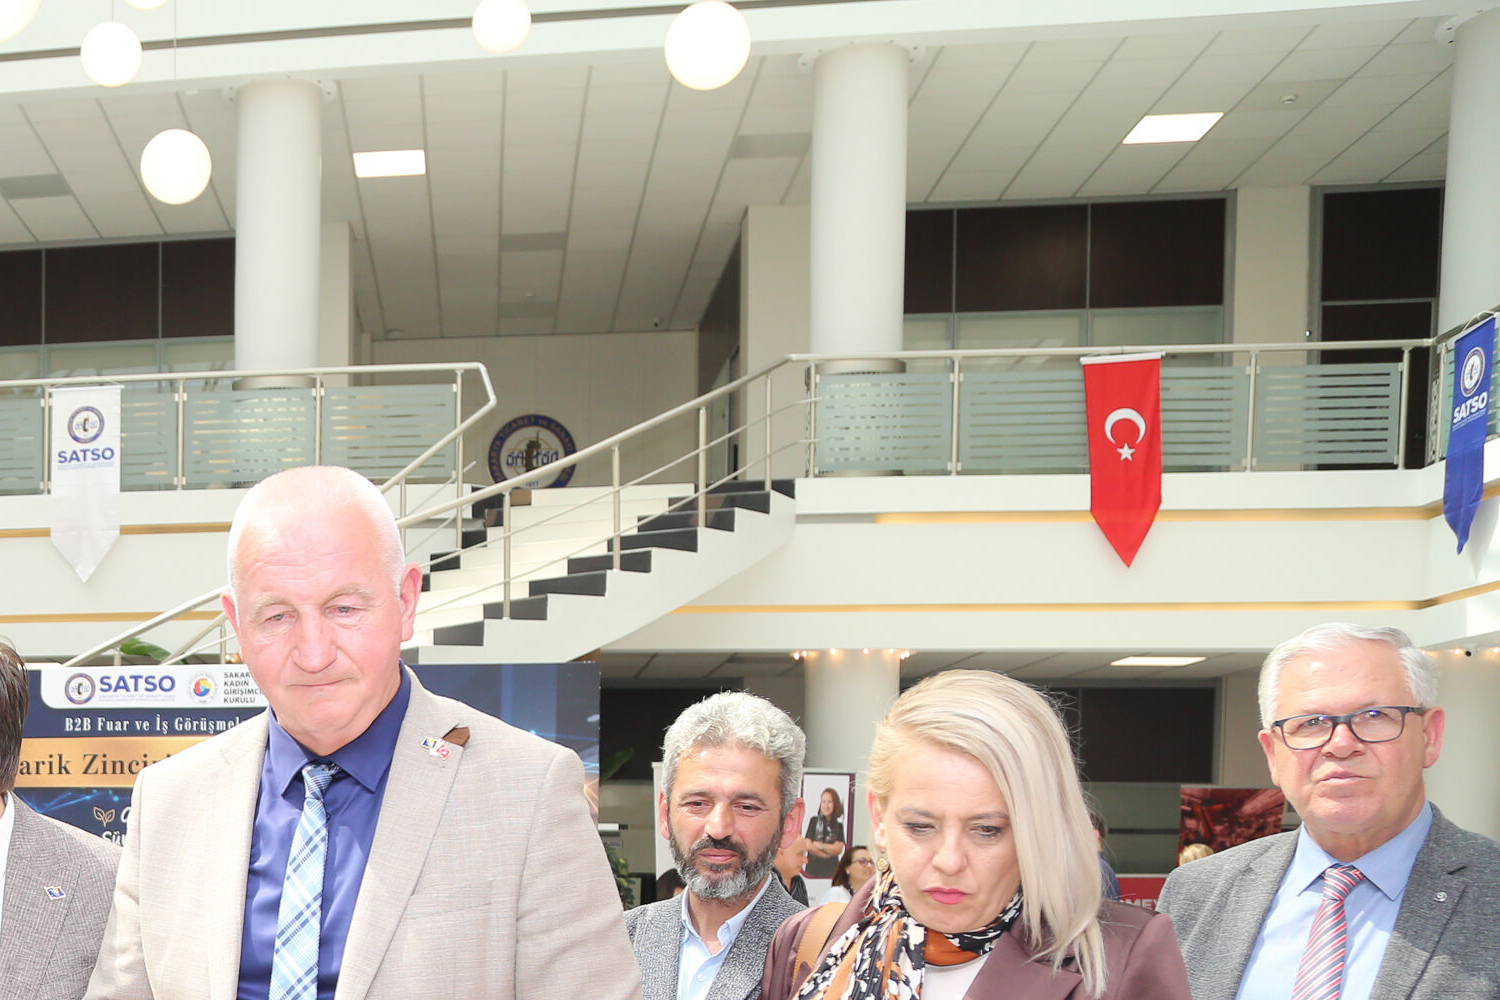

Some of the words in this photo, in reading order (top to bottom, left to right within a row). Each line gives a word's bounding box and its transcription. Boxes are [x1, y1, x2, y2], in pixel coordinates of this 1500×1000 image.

[1452, 391, 1488, 423] SATSO
[57, 447, 115, 464] SATSO
[99, 674, 176, 693] SATSO
[65, 717, 92, 731] B2B
[97, 717, 130, 731] Fuar
[135, 720, 150, 731] ve
[155, 713, 169, 734] İş
[19, 753, 72, 775] arik
[82, 753, 171, 775] Zinci
